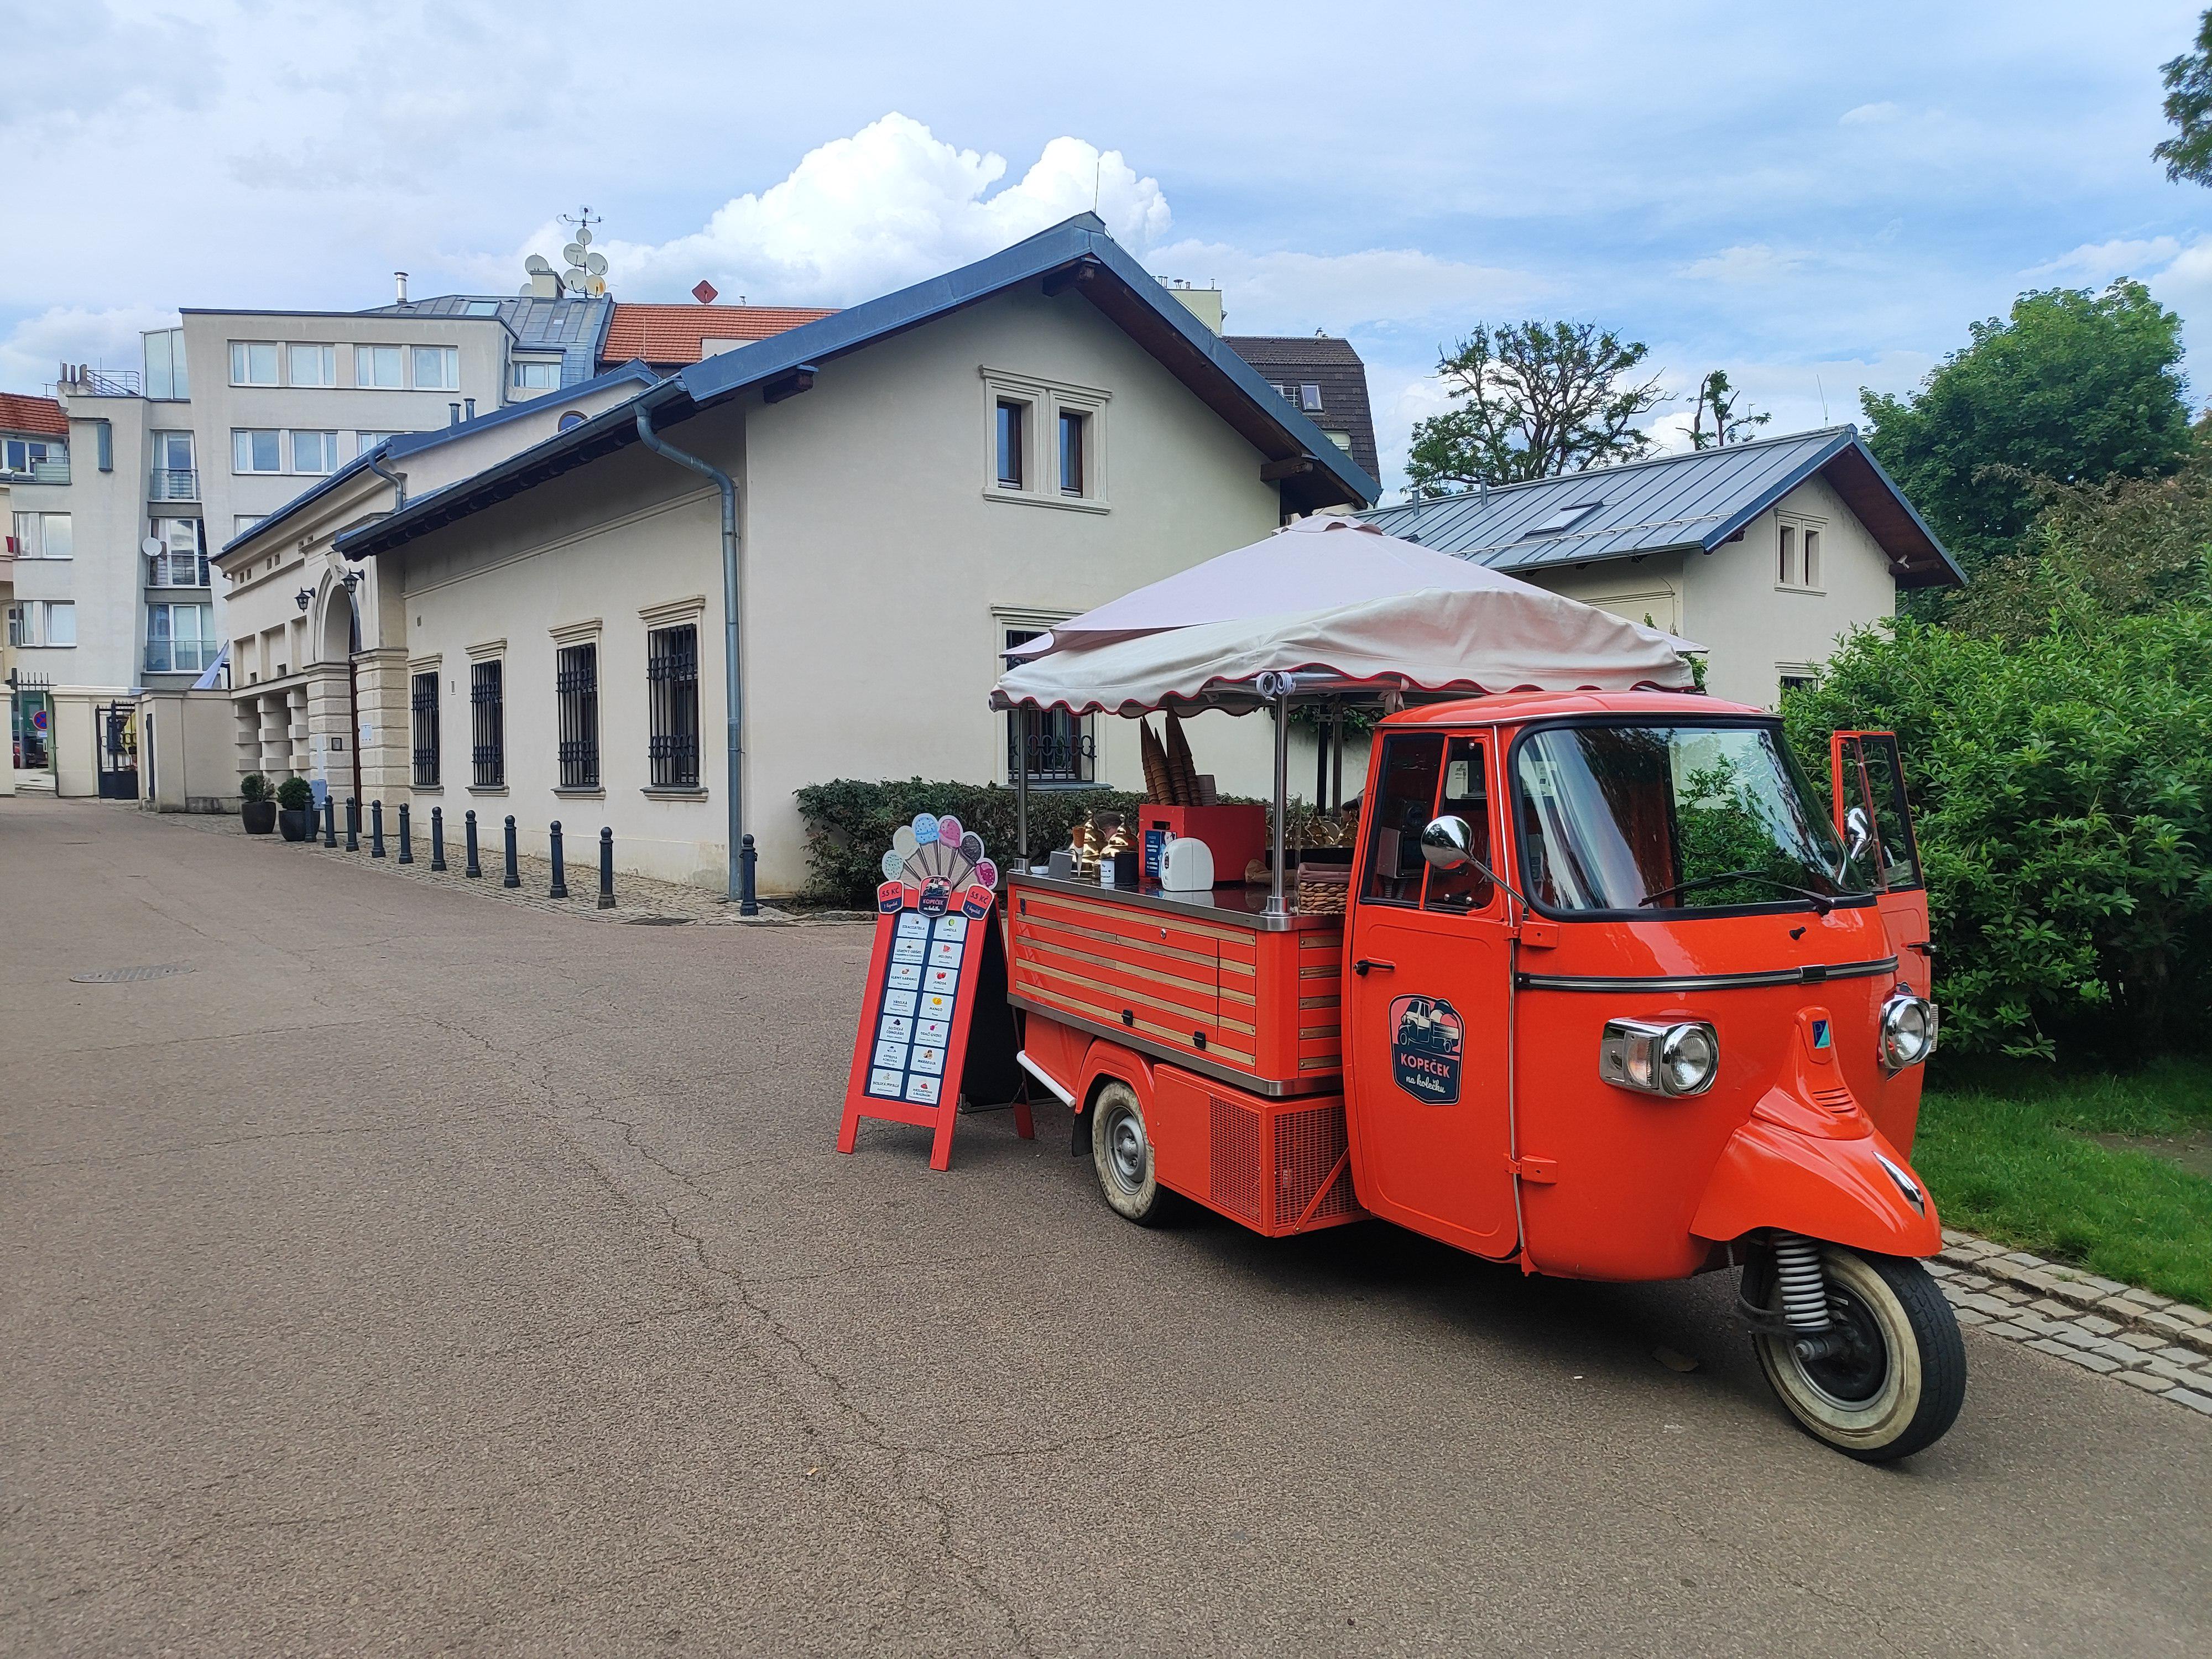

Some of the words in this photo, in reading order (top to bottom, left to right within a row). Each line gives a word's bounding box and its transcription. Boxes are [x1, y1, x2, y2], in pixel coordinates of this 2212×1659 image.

[1401, 1052, 1450, 1078] KOPEČEK
[1406, 1076, 1416, 1084] na
[1416, 1073, 1446, 1093] kolečku
